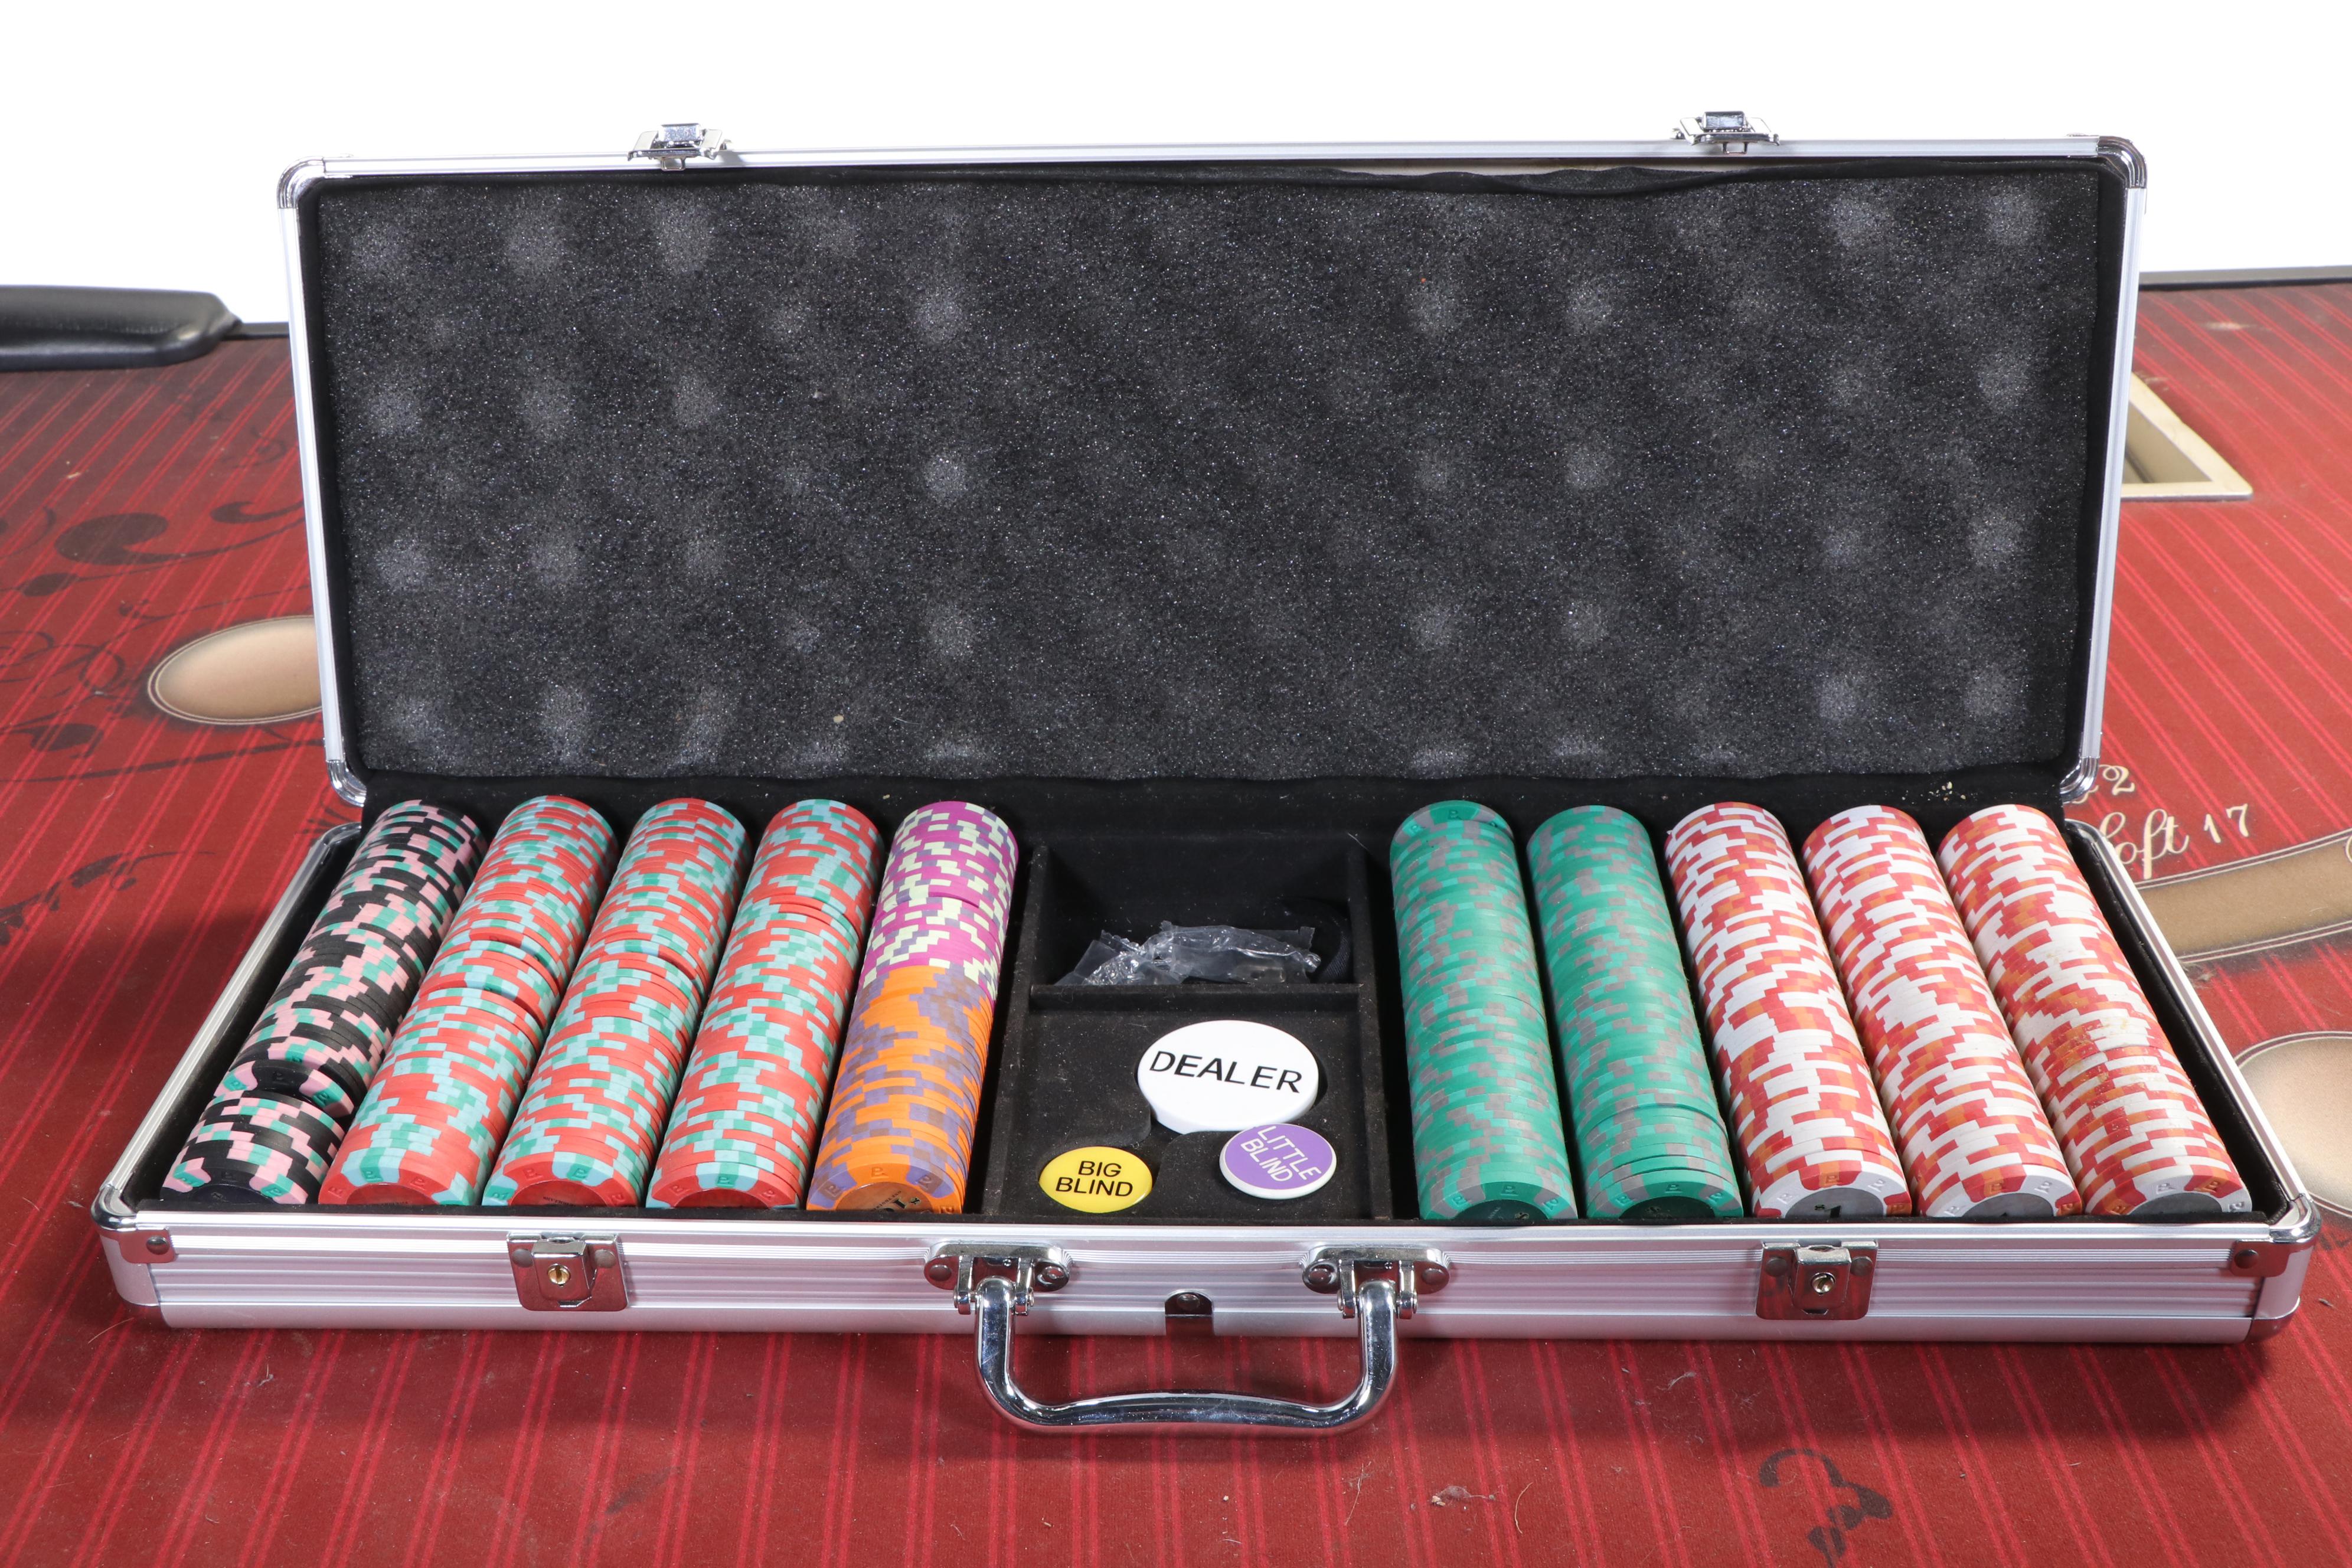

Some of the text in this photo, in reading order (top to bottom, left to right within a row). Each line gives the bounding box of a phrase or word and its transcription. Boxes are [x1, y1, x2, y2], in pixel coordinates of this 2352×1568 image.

[2203, 803, 2249, 844] 17
[1149, 1050, 1302, 1093] DEALER
[1077, 1160, 1122, 1177] BIG
[1240, 1138, 1293, 1181] BLIND
[1257, 1125, 1322, 1181] LITTLE
[1055, 1177, 1133, 1197] BLIND
